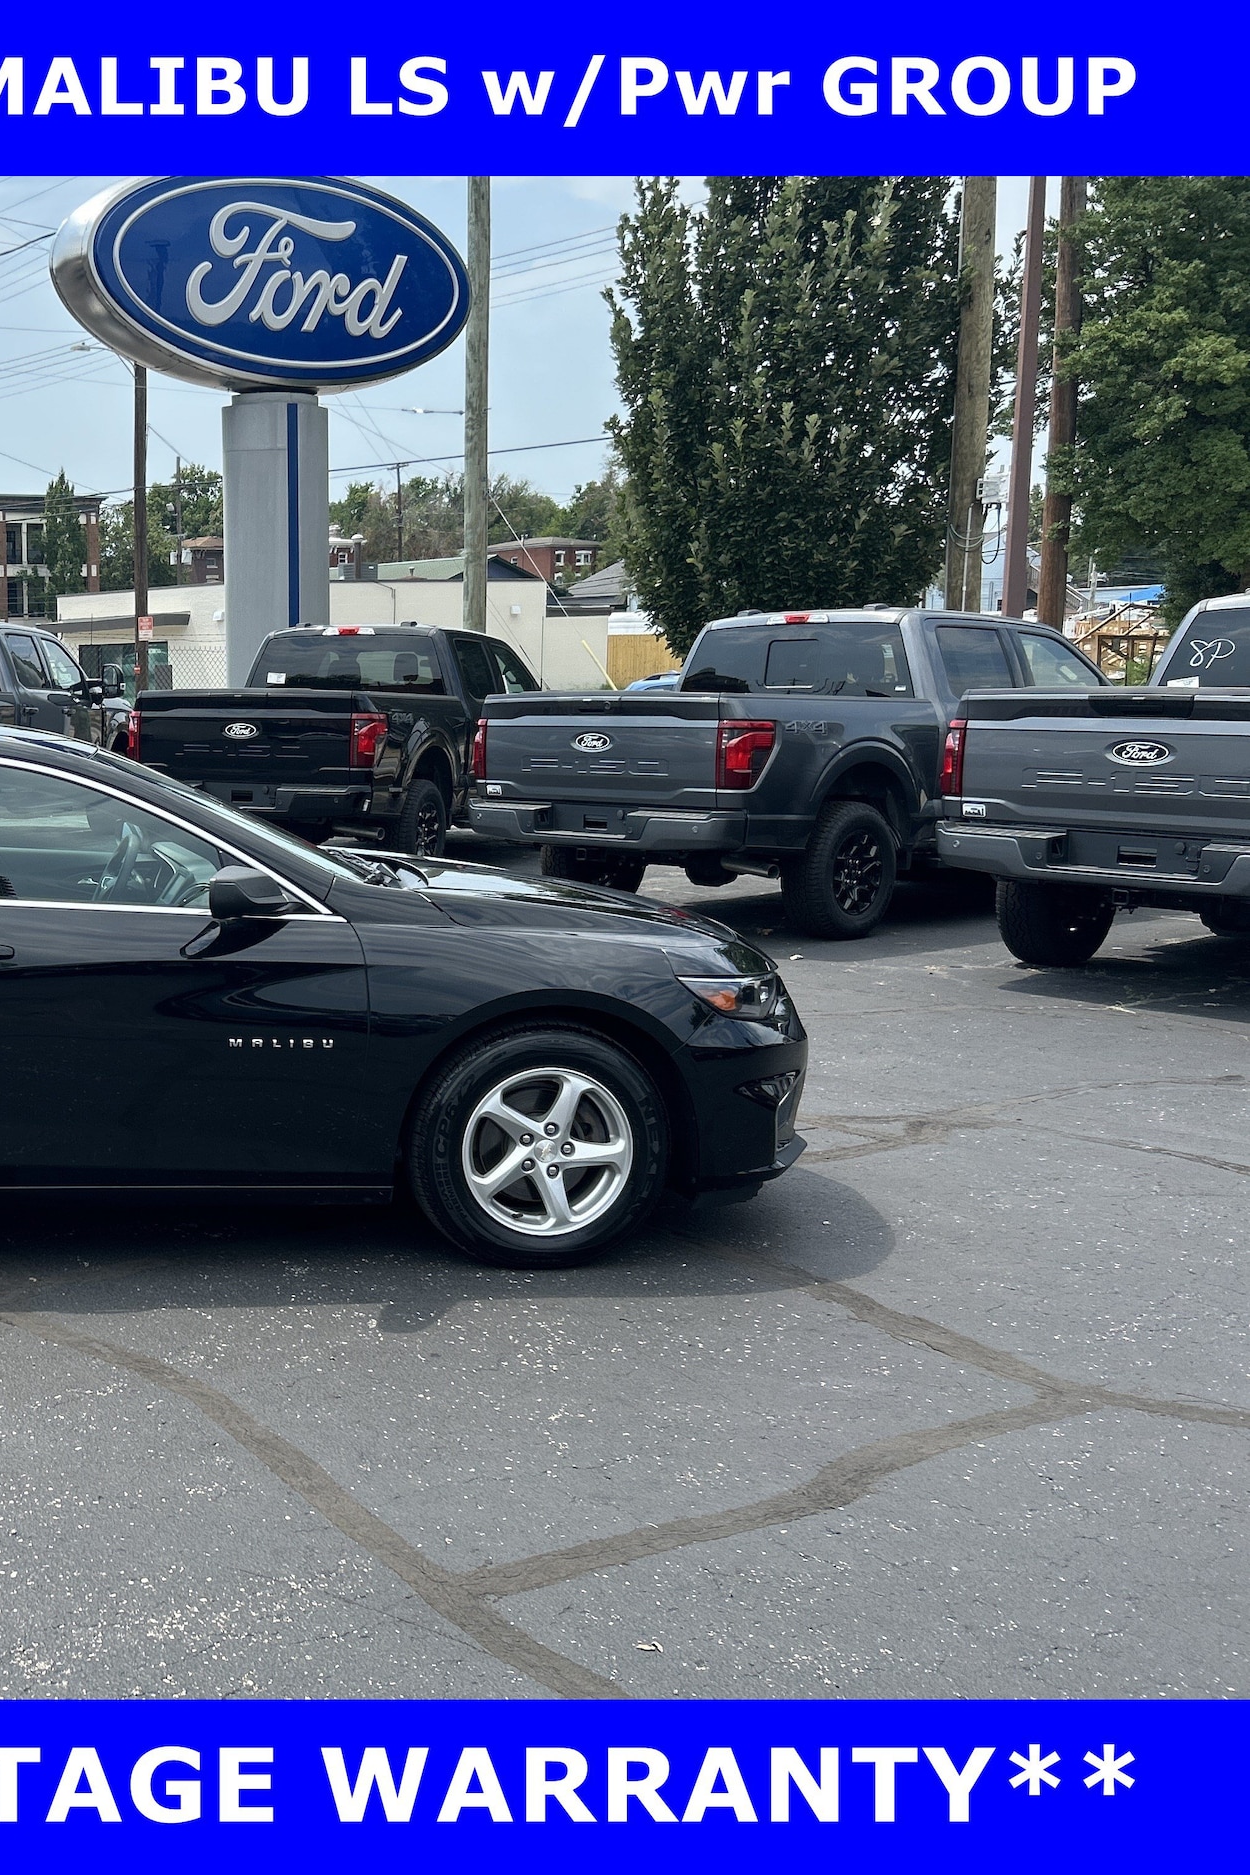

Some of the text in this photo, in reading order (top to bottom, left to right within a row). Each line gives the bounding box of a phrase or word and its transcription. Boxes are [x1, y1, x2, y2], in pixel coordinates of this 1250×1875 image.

[186, 201, 408, 339] Ford
[1120, 743, 1160, 760] Ford
[521, 755, 669, 777] F-150
[228, 1037, 334, 1049] MALIBU
